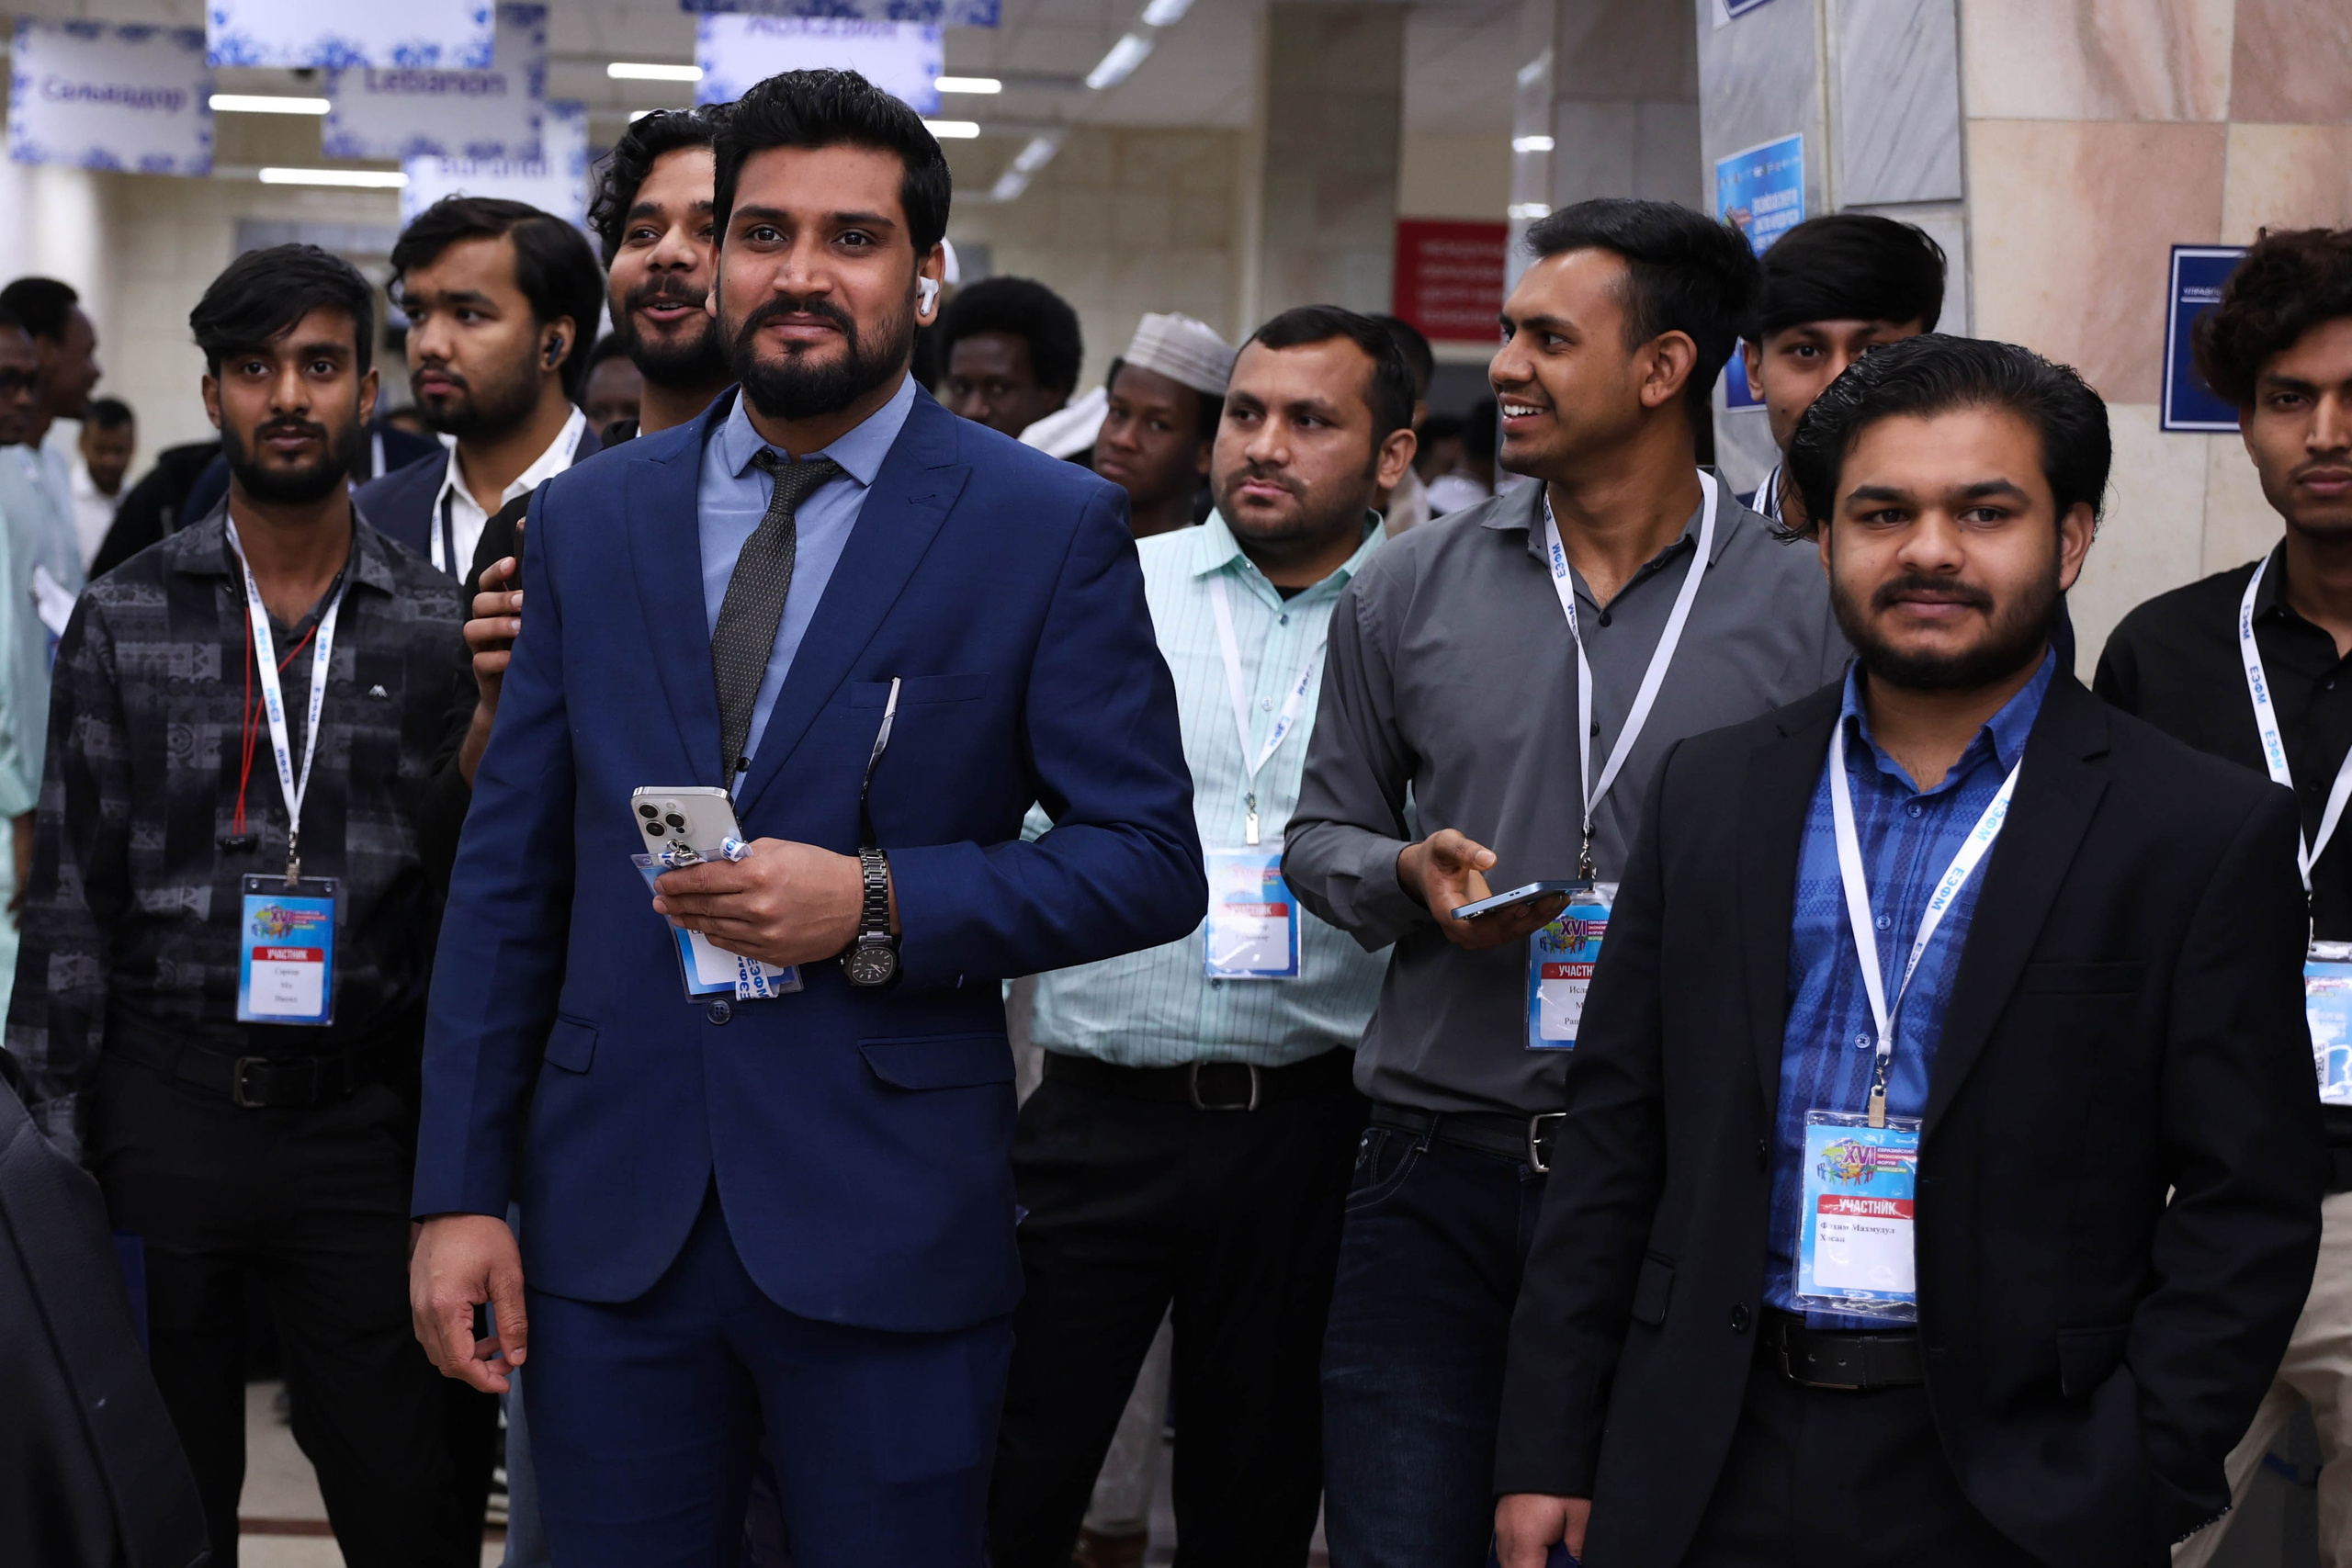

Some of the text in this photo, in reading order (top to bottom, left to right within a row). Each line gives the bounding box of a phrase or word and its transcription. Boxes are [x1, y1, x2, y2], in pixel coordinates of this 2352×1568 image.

[365, 66, 505, 95] Lebanon
[1552, 543, 1566, 579] ЕЭФМ
[2250, 666, 2267, 705] ЕЭФМ
[2266, 730, 2283, 769] ЕЭФМ
[1975, 797, 2010, 841] ЕЭФМ
[1931, 867, 1965, 911] ЕЭФМ
[1560, 919, 1587, 936] XVI
[1559, 965, 1594, 976] УЧАСТН
[1842, 1144, 1876, 1166] XVI
[1839, 1199, 1896, 1215] УЧАСТНИК
